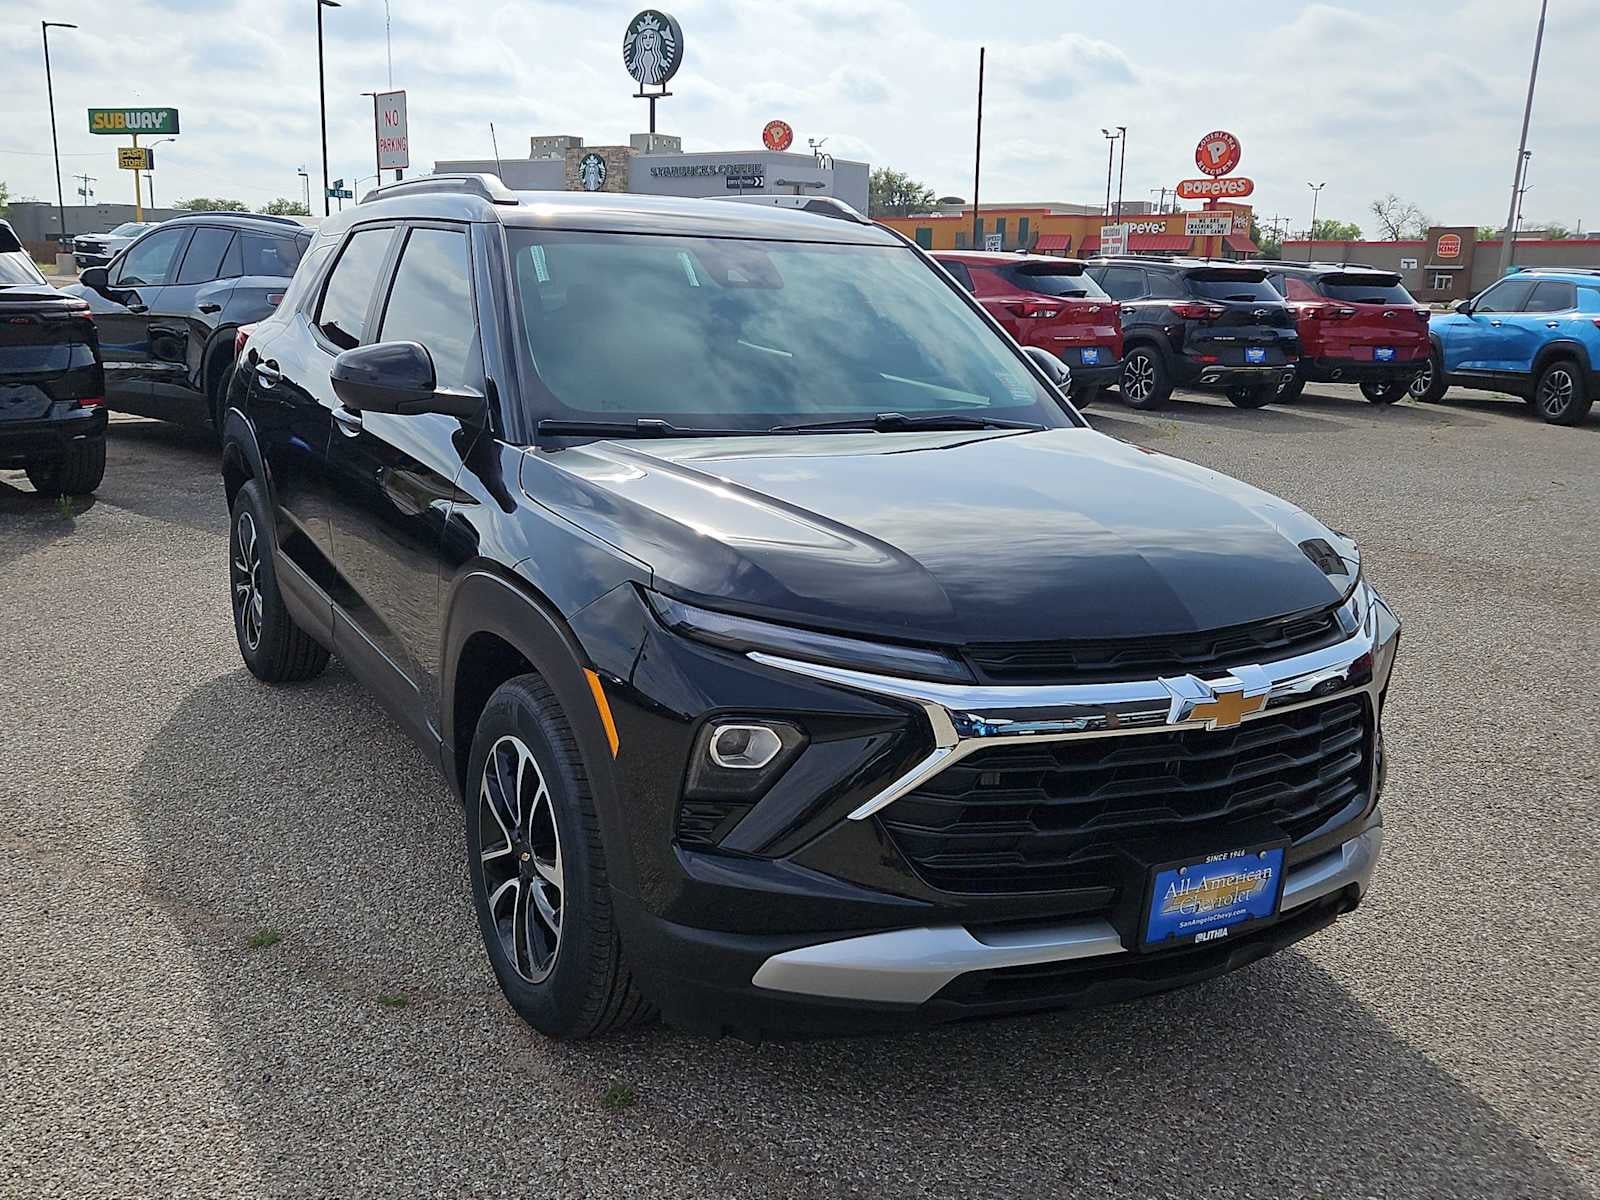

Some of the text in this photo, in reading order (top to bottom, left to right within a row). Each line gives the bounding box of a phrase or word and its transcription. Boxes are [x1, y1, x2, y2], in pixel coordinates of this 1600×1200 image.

[93, 111, 167, 129] SUBWAY
[384, 109, 399, 127] NO
[379, 137, 407, 153] PARKING
[1198, 132, 1237, 151] LOUISIANA
[121, 150, 144, 158] CASH
[1207, 142, 1227, 164] P
[120, 159, 146, 168] STORE
[650, 163, 717, 177] STARBUCKS
[1198, 159, 1233, 175] KITCHEN
[1205, 853, 1228, 863] SINCE
[1164, 867, 1272, 899] All American
[1179, 887, 1251, 915] Chevrolet
[1179, 909, 1247, 928] SanAngeloChevy.com
